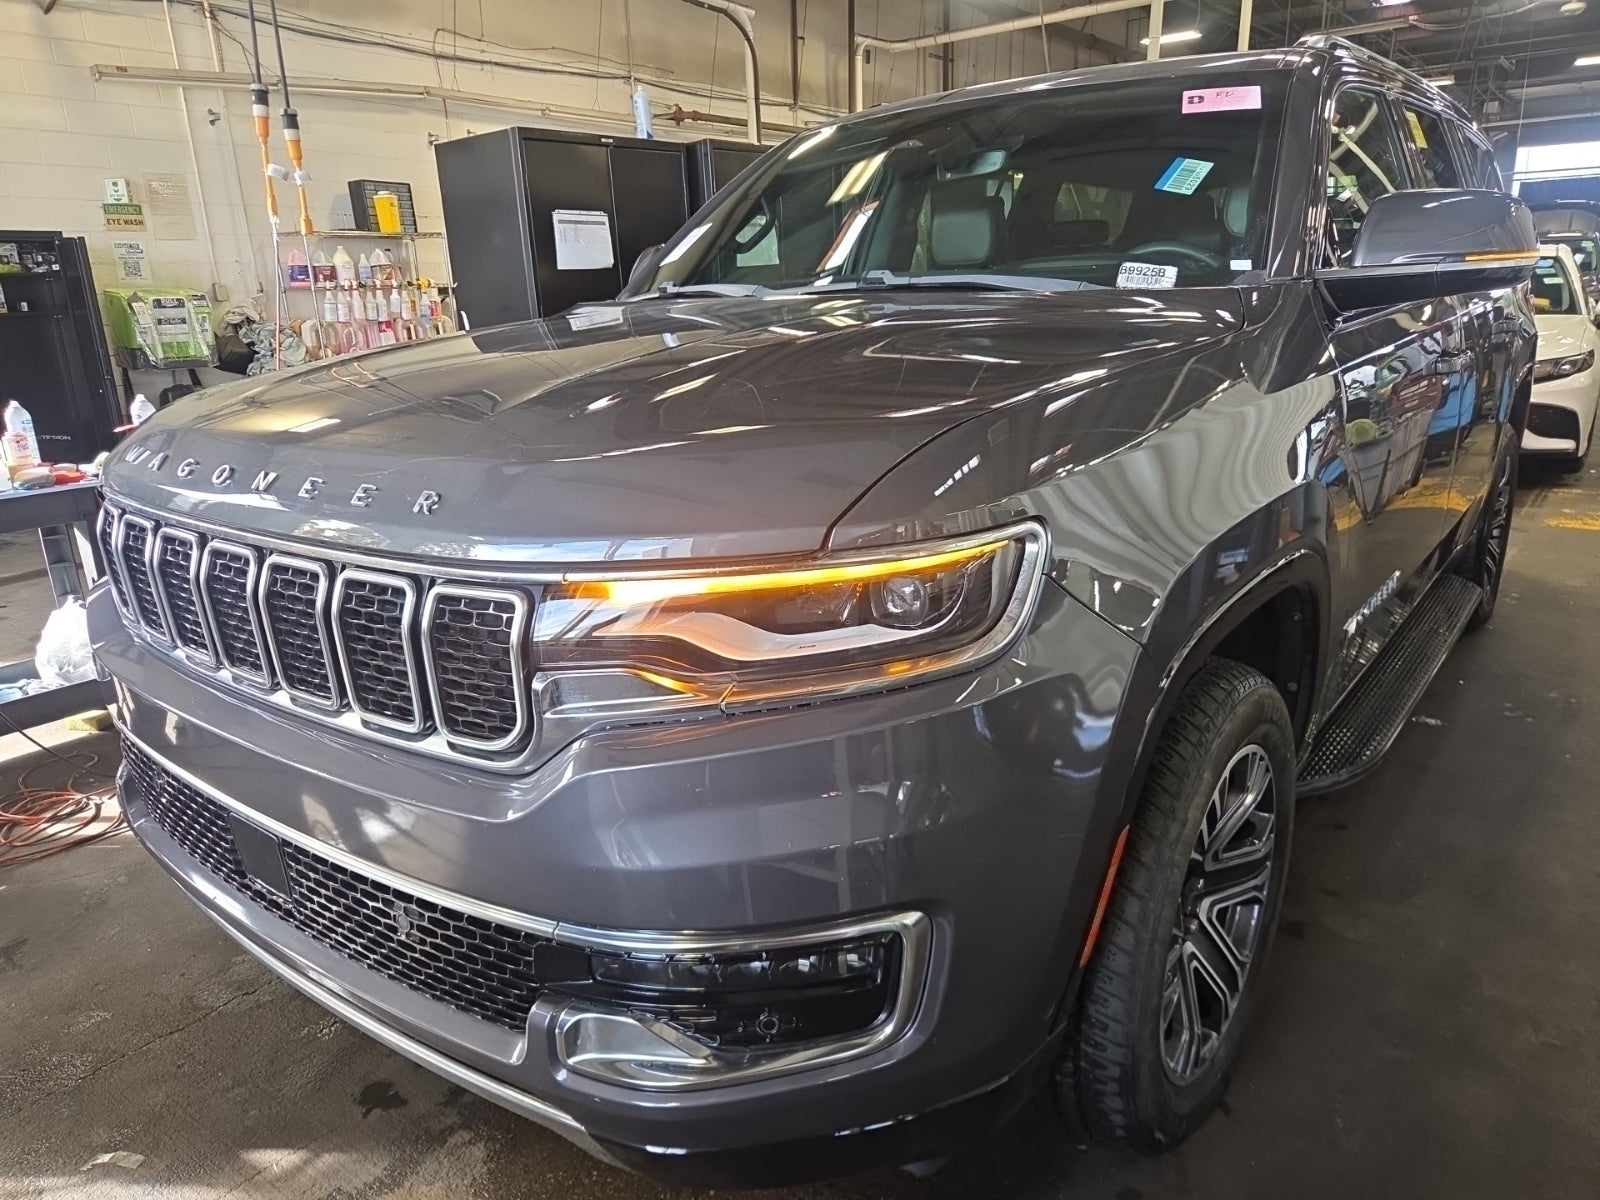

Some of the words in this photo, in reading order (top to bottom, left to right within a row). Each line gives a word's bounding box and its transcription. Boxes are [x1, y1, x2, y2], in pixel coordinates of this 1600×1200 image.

[104, 205, 140, 215] EMERGENCY
[106, 218, 122, 226] EYE
[123, 218, 144, 226] WASH
[1119, 265, 1167, 278] B9925B
[124, 446, 442, 515] WAGONEER
